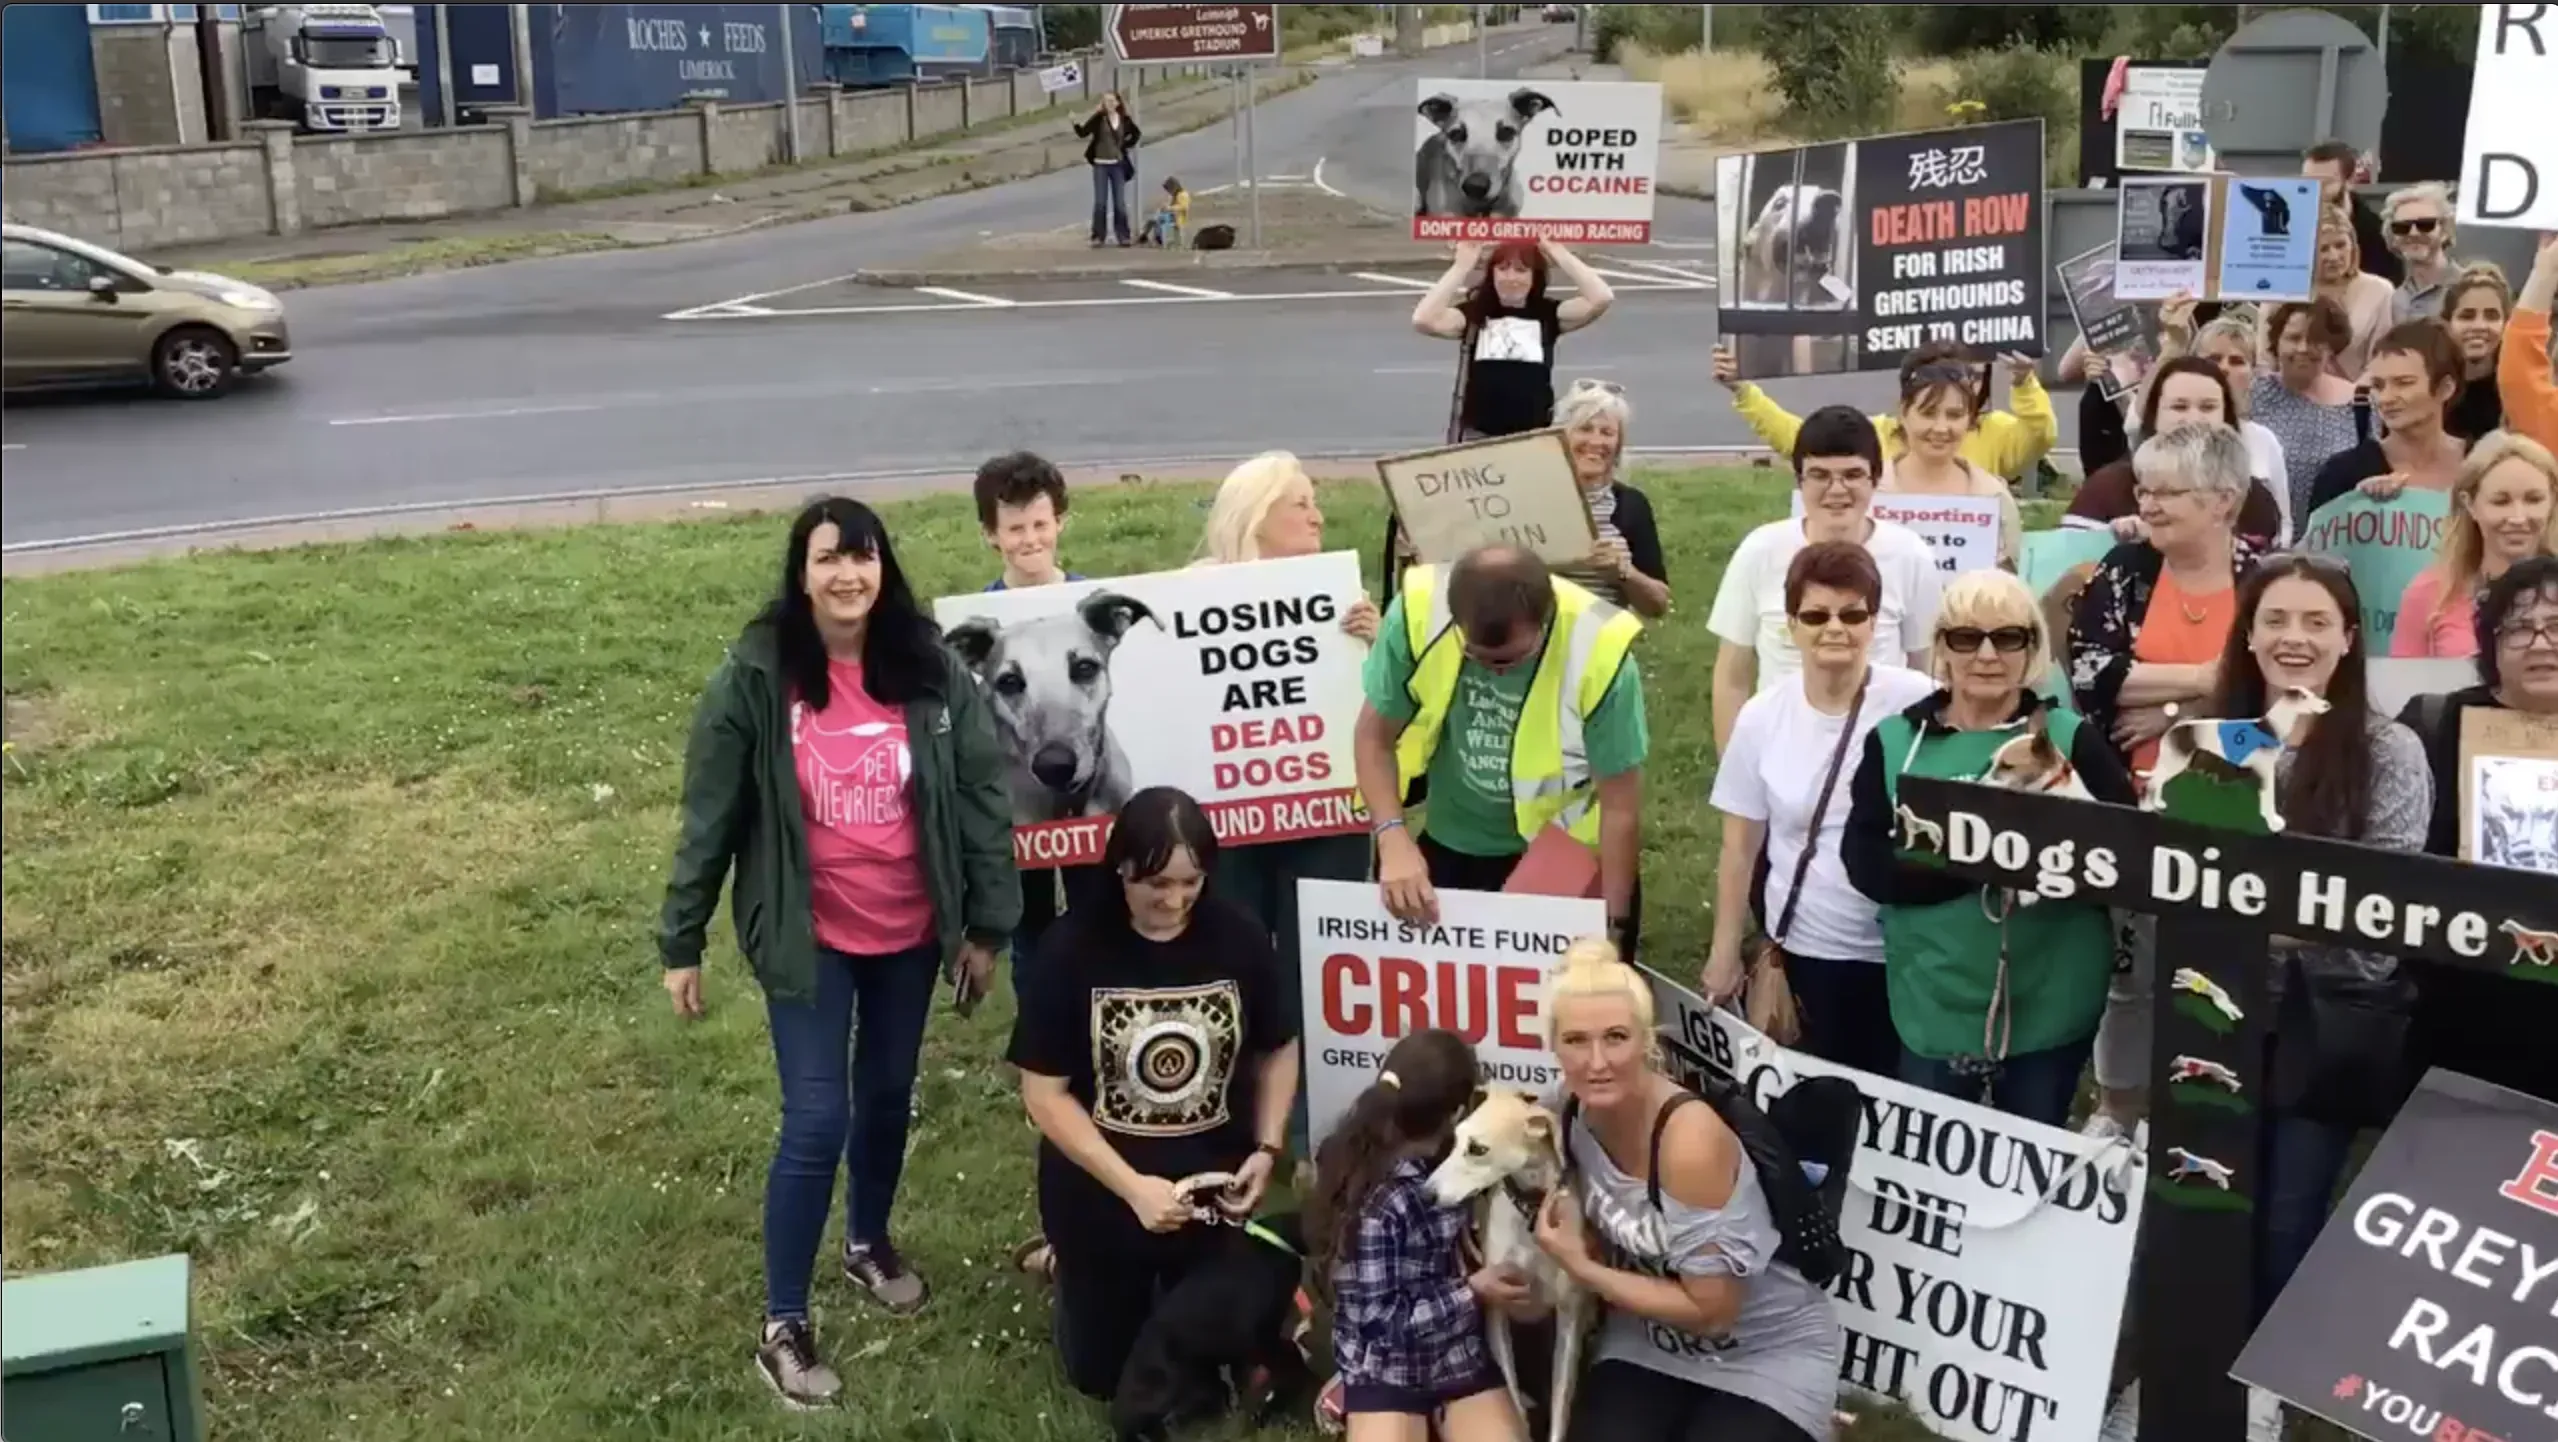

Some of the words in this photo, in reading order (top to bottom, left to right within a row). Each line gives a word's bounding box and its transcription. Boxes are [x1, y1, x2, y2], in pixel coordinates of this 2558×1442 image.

[627, 18, 687, 51] ROCHES
[724, 22, 766, 52] FEEDS
[1130, 26, 1179, 41] LIMERICK
[1180, 23, 1247, 38] GREYHOUND
[1193, 38, 1241, 52] STADIUM
[679, 60, 735, 80] LIMERICK
[1547, 128, 1637, 147] DOPED
[1556, 152, 1624, 170] WITH
[1908, 146, 1988, 192] 残忍
[1528, 175, 1649, 194] COCAINE
[2475, 152, 2539, 220] D
[1420, 221, 1463, 237] DON'T
[1467, 222, 1488, 237] GO
[1493, 222, 1584, 239] GREYHOUND
[1588, 223, 1644, 240] RACING
[1871, 201, 1955, 246] DEATH
[1964, 193, 2029, 236] ROW
[1893, 251, 1936, 279] FOR
[1943, 246, 2004, 275] IRISH
[1875, 280, 2025, 316] GREYHOUNDS
[1867, 324, 1920, 352] SENT
[1928, 322, 1956, 343] TO
[1962, 315, 2034, 344] CHINA
[1415, 464, 1506, 497] DYING
[1465, 494, 1511, 520] TO
[1873, 505, 1993, 528] Exporting
[1943, 533, 1967, 547] to
[1174, 593, 1335, 640] LOSING
[1200, 635, 1319, 675] DOGS
[1222, 677, 1307, 712] ARE
[1212, 714, 1325, 753] DEAD
[864, 743, 897, 784] PET
[1213, 752, 1331, 790] DOGS
[1947, 811, 2118, 898] Dogs
[2150, 846, 2267, 915] Die
[2297, 871, 2488, 956] Here
[1318, 917, 1388, 942] IRISH
[1398, 921, 1485, 949] STATE
[1496, 930, 1575, 955] FUND
[1322, 953, 1543, 1050] CRUE
[1678, 1002, 1734, 1069] IGB
[1323, 1048, 1385, 1069] GREY
[1482, 1061, 1561, 1085] NDUST
[1868, 1176, 1967, 1258] DIE
[2353, 1193, 2558, 1317] GREY
[1893, 1263, 2049, 1370] YOUR
[2388, 1297, 2558, 1420] RAC
